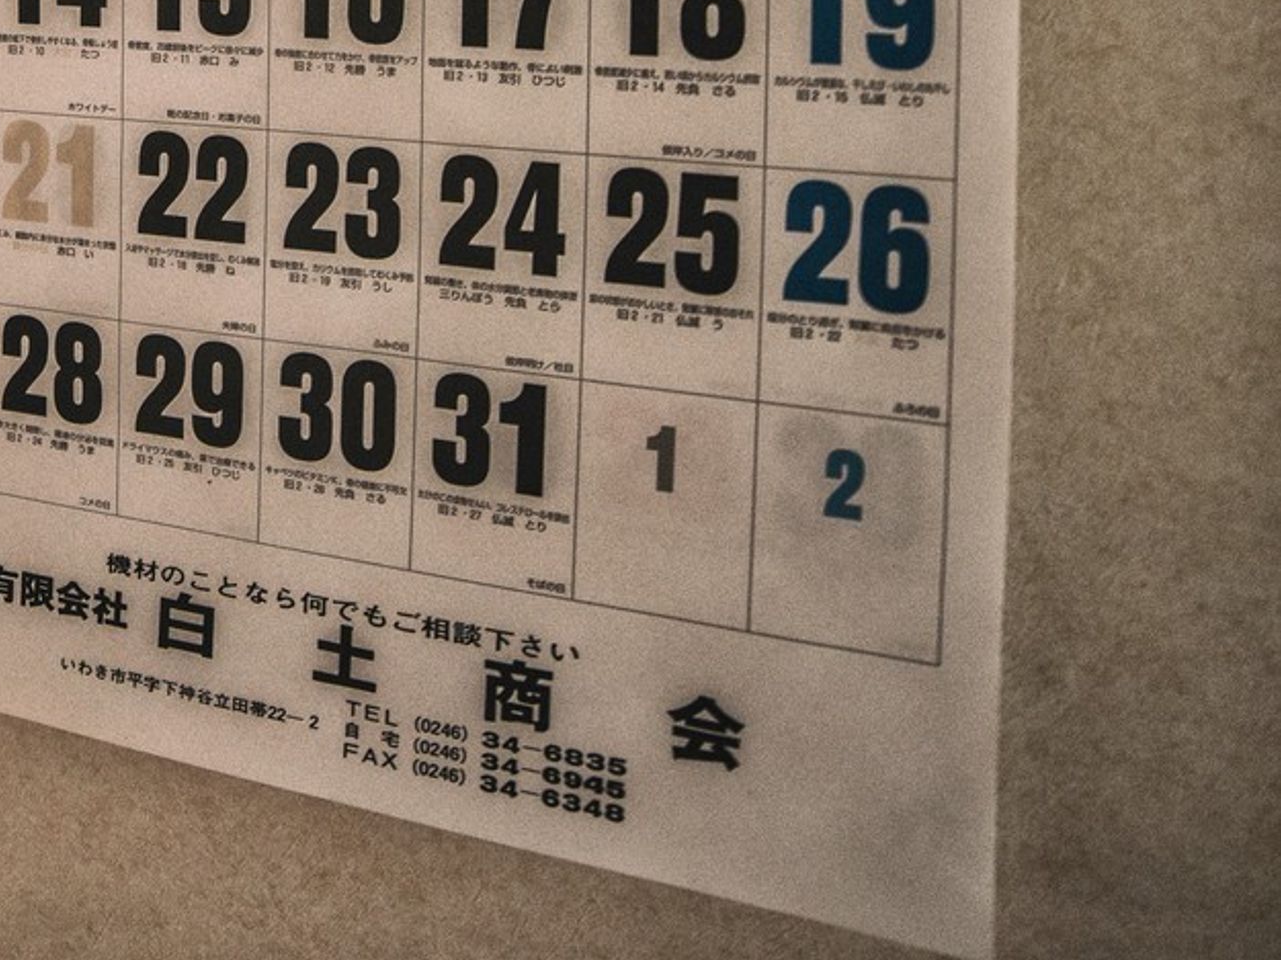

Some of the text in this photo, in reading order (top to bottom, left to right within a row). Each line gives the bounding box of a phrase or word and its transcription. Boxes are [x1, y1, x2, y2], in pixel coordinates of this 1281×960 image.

[68, 103, 116, 113] ホワイトデー
[3, 121, 95, 228] 21
[138, 131, 248, 244] 22
[284, 142, 400, 259] 23
[439, 155, 565, 277] 24
[604, 167, 739, 296] 25
[783, 180, 930, 315] 26
[2, 315, 102, 424] 28
[135, 334, 243, 448] 29
[278, 352, 396, 471] 30
[432, 373, 547, 498] 31
[647, 426, 676, 493] 1
[823, 449, 865, 521] 2
[105, 552, 580, 662] 機材のことなら何でもご相談下さい
[345, 700, 398, 727] TEL
[414, 717, 468, 741] (0246)
[343, 743, 397, 770] FAX
[412, 759, 466, 786] (0246)
[345, 723, 399, 748] 自宅
[413, 738, 467, 764] (0246)
